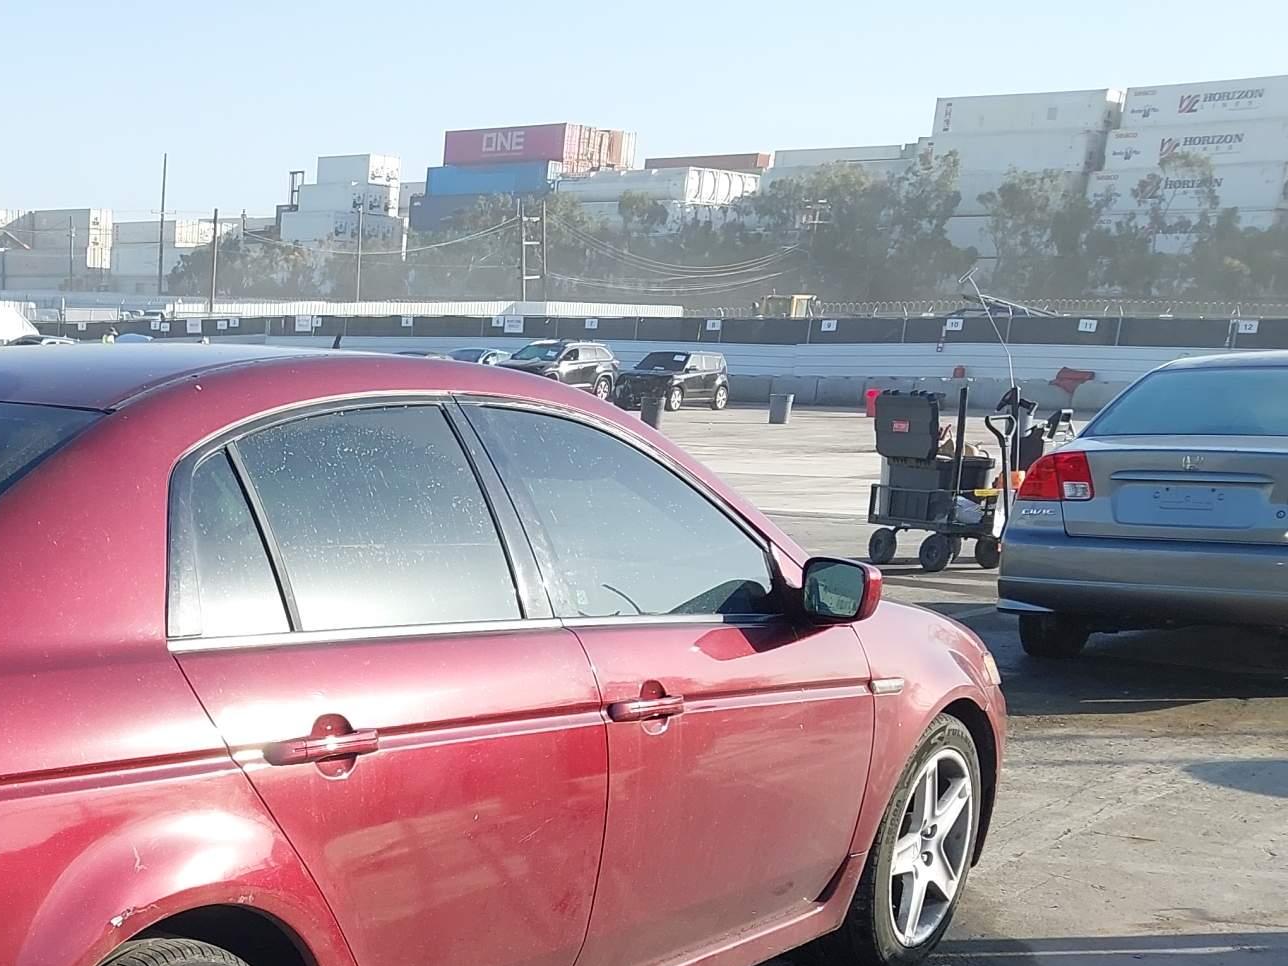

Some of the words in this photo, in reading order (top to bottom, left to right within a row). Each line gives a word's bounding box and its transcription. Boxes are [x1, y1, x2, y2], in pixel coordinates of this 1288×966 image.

[1202, 88, 1265, 103] HORIZON
[482, 131, 525, 152] ONE
[1182, 133, 1245, 147] HORIZON
[1243, 323, 1254, 331] 12
